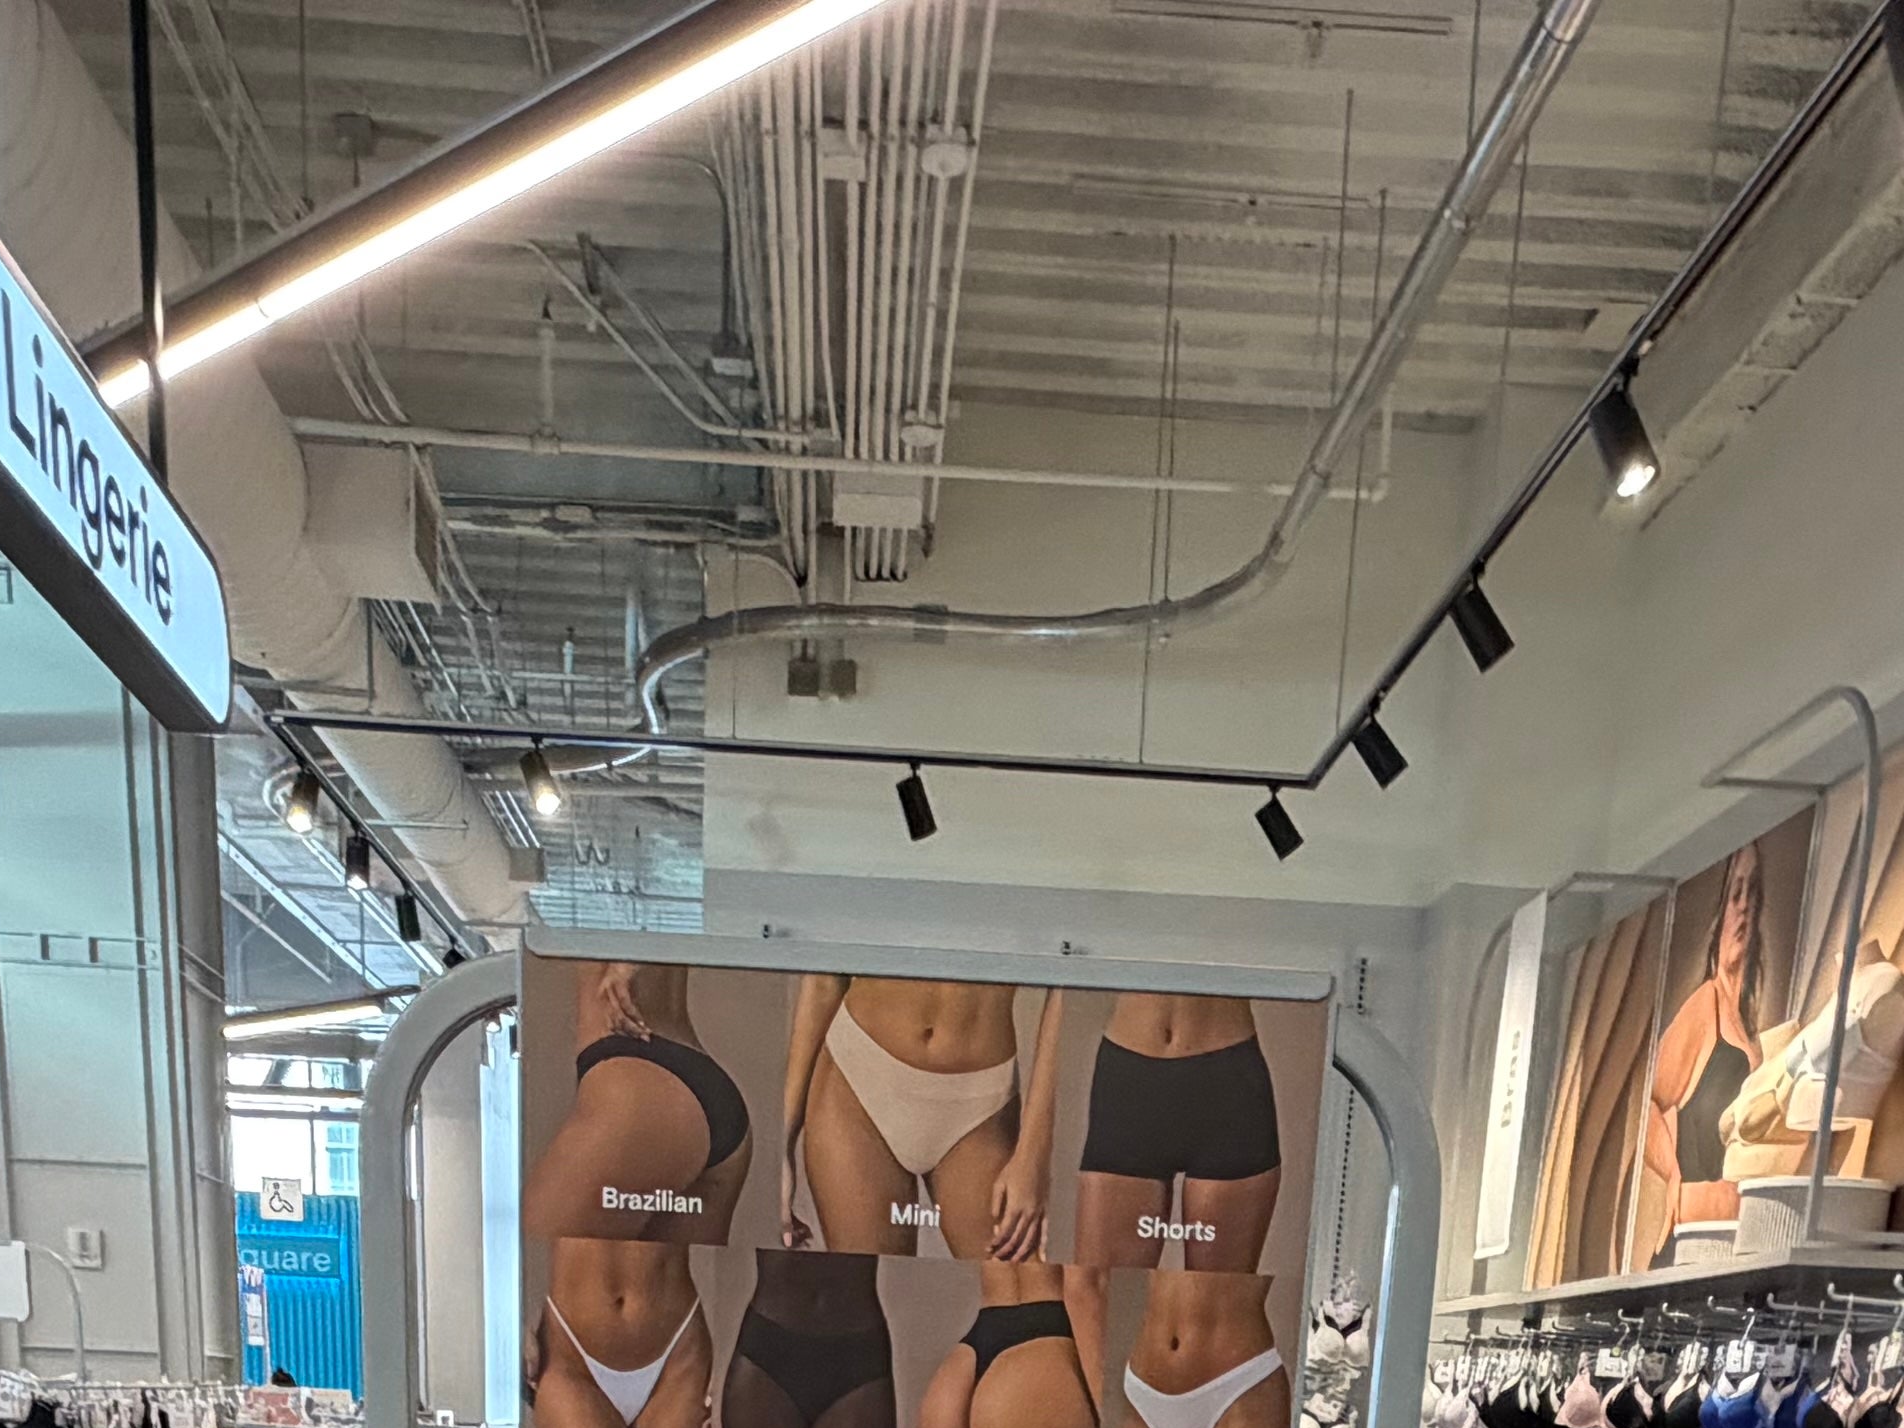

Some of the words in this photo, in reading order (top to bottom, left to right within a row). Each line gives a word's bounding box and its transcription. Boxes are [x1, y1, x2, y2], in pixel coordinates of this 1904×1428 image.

[1, 288, 172, 626] Lingerie
[601, 1187, 703, 1214] Brazilian
[890, 1202, 941, 1229] Mini
[1137, 1216, 1217, 1243] Shorts
